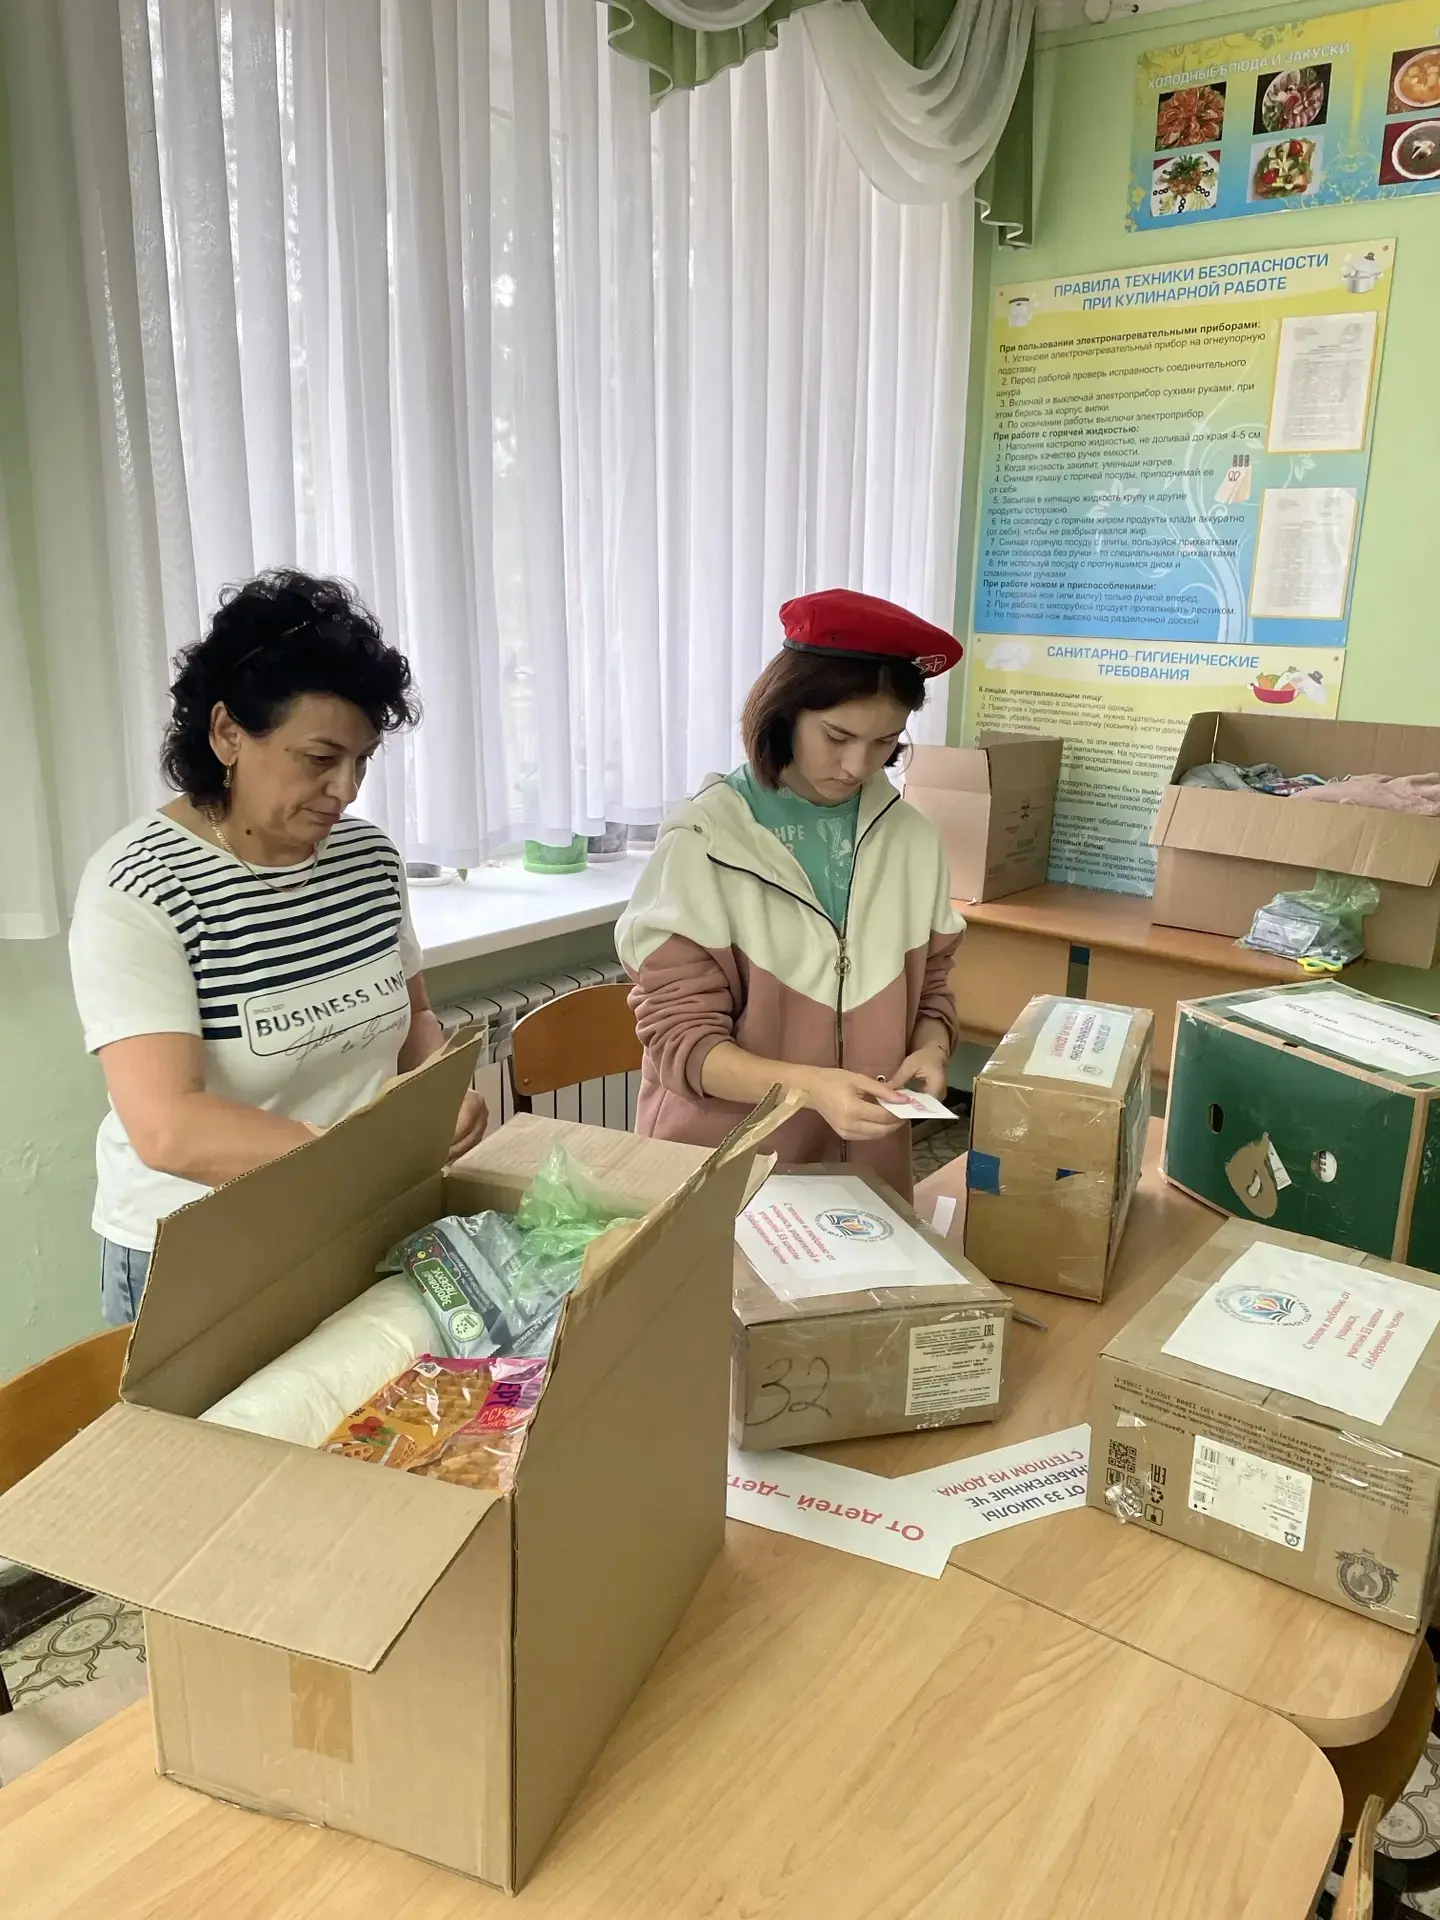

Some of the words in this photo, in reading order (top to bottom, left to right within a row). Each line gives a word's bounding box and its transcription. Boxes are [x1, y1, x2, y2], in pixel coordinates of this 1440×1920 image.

[1148, 67, 1217, 88] ХОЛОДНЫЕ
[1219, 57, 1267, 76] БЛЮДА
[1271, 54, 1282, 66] И
[1285, 42, 1350, 64] ЗАКУСКИ
[1054, 277, 1121, 298] ПРАВИЛА
[1125, 268, 1194, 288] ТЕХНИКИ
[1198, 253, 1329, 280] БЕЗОПАСНОСТИ
[1082, 296, 1111, 311] ПРИ
[1115, 281, 1220, 308] КУЛИНАРНОЙ
[1224, 276, 1287, 296] РАБОТЕ
[1000, 344, 1016, 354] При
[1018, 339, 1074, 351] пользовании
[1076, 327, 1197, 345] электронагревательными
[1200, 322, 1261, 335] приборами:
[1012, 352, 1048, 362] Установи
[1050, 341, 1152, 359] электронагревательный
[1154, 339, 1188, 351] прибор
[1203, 333, 1266, 345] огнеупорную
[1010, 375, 1036, 386] Перед
[1038, 371, 1070, 384] работой
[1072, 370, 1107, 381] проверь
[1108, 366, 1164, 377] исправность
[1166, 359, 1246, 372] соединительного
[1008, 396, 1044, 407] Включай
[1052, 392, 1094, 404] выключай
[1096, 389, 1160, 401] электроприбор
[1162, 387, 1196, 398] сухими
[1198, 385, 1234, 396] руками,
[1237, 383, 1254, 393] при
[994, 411, 1013, 419] этом
[1014, 409, 1042, 419] берись
[1044, 408, 1054, 416] за
[1056, 406, 1082, 416] корпус
[1007, 419, 1018, 428] По
[1020, 418, 1062, 428] окончании
[1063, 416, 1094, 427] работы
[1096, 414, 1133, 423] выключи
[993, 431, 1010, 442] При
[1011, 430, 1040, 441] работе
[1042, 430, 1047, 438] с
[1048, 427, 1084, 439] горячей
[1086, 426, 1140, 436] жидкостью:
[1046, 440, 1086, 449] кастрюлю
[1152, 433, 1190, 445] доливай
[1192, 434, 1204, 443] до
[1206, 433, 1228, 443] края
[1230, 431, 1246, 440] 4-5
[1004, 463, 1026, 473] Когда
[1028, 463, 1064, 472] жидкость
[1102, 460, 1140, 470] уменьши
[1005, 452, 1038, 463] Проверь
[1040, 451, 1076, 460] качество
[1078, 450, 1100, 460] ручек
[1000, 516, 1011, 525] На
[1061, 516, 1094, 526] горячим
[1096, 516, 1124, 525] жиром
[1126, 516, 1166, 525] продукты
[1169, 515, 1196, 524] клади
[1198, 515, 1244, 524] аккуратно
[983, 578, 998, 589] При
[1000, 579, 1028, 589] работе
[1060, 581, 1064, 589] и
[1067, 581, 1156, 591] приспособлениями:
[1097, 664, 1190, 681] ТРЕБОВАНИЯ
[255, 988, 370, 1038] BUSINESS
[745, 1356, 833, 1427] 32
[1071, 1450, 1084, 1460] С
[1010, 1453, 1074, 1478] ТЕПЛОМ
[988, 1471, 1011, 1484] ИЗ
[1043, 1491, 1065, 1503] 33
[1064, 1485, 1085, 1497] ОТ
[796, 1494, 883, 1526] детей
[980, 1496, 1045, 1522] ШКОЛЫ
[886, 1520, 925, 1542] От
